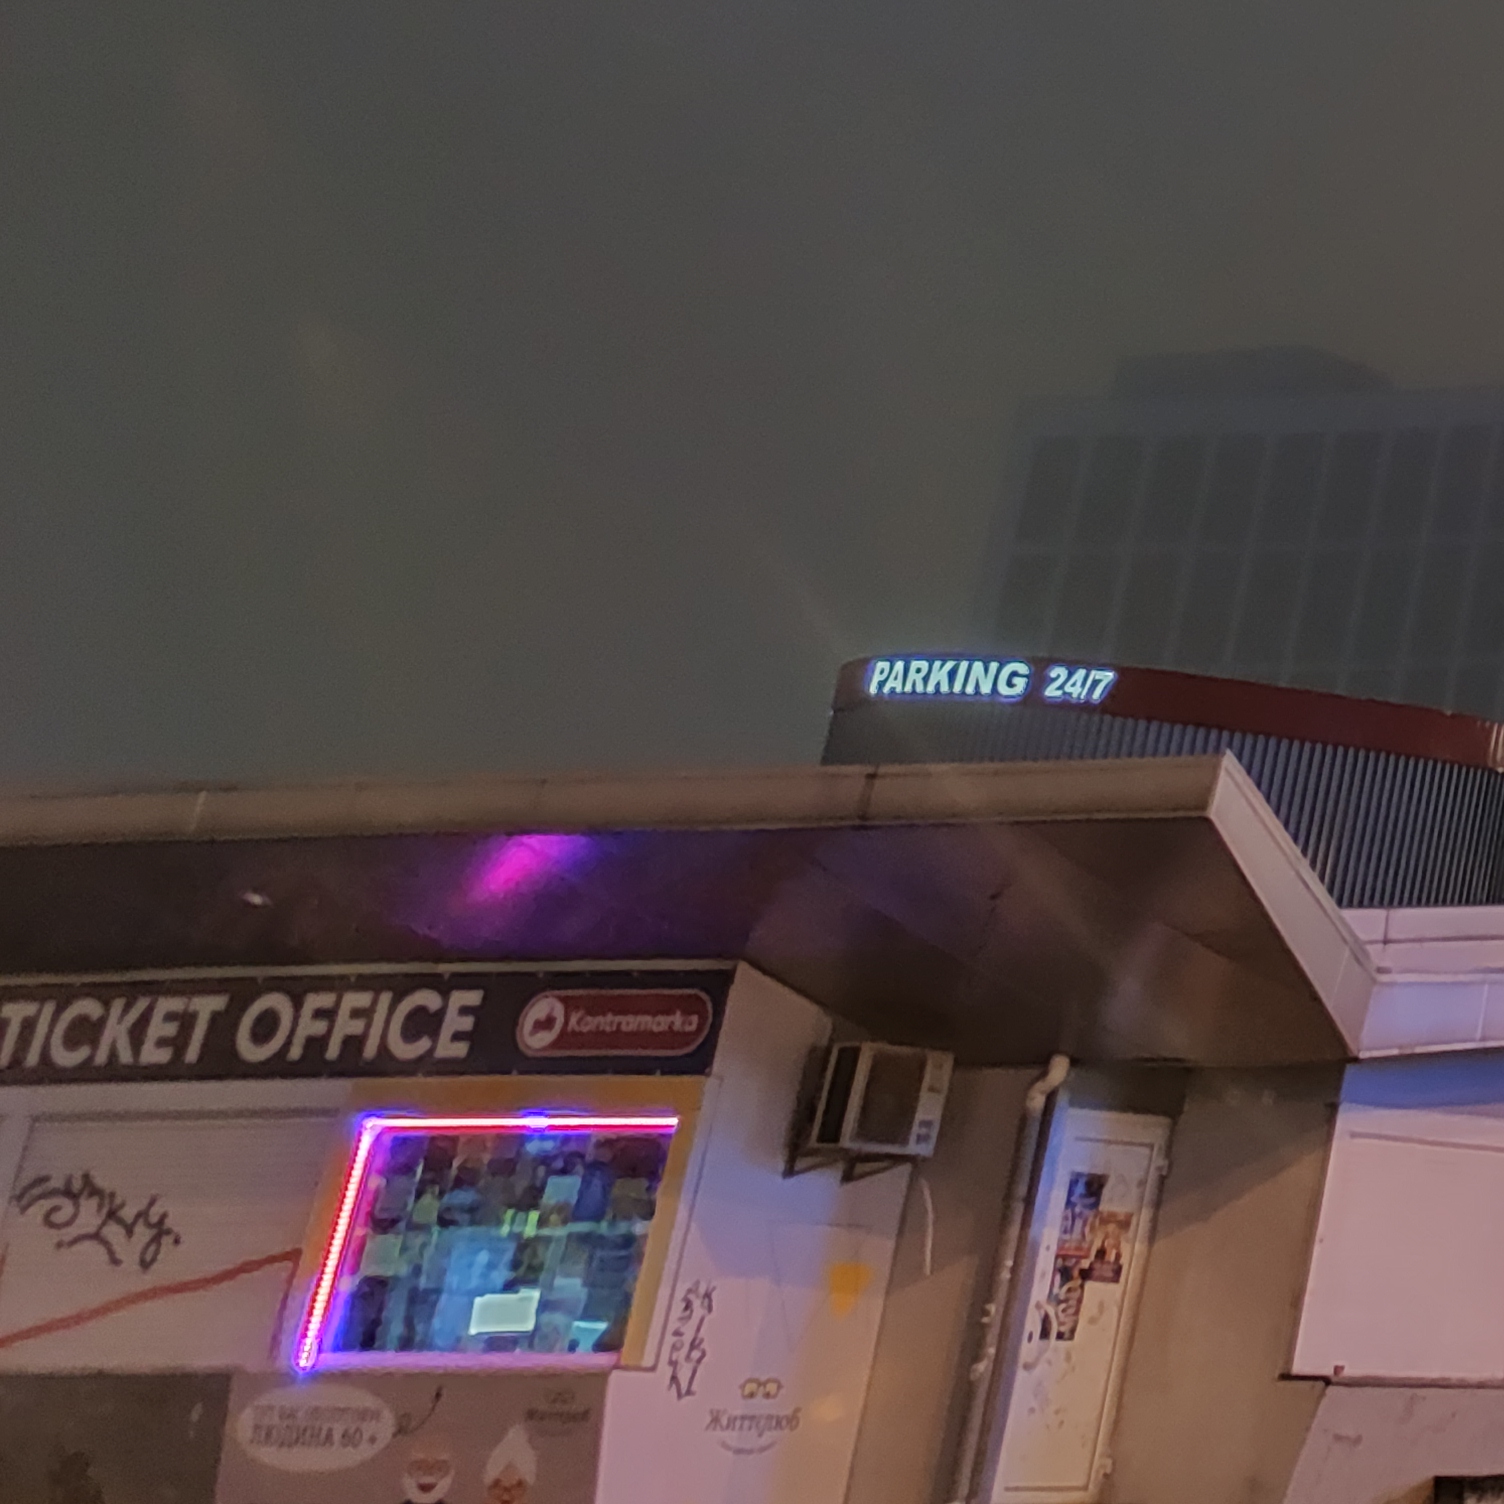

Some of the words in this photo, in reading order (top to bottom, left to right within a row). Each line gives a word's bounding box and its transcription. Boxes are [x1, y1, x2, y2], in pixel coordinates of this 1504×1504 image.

[869, 660, 1031, 697] PARKING
[1044, 666, 1115, 702] 24/7
[0, 994, 226, 1070] TICKET
[235, 989, 484, 1063] OFFICE
